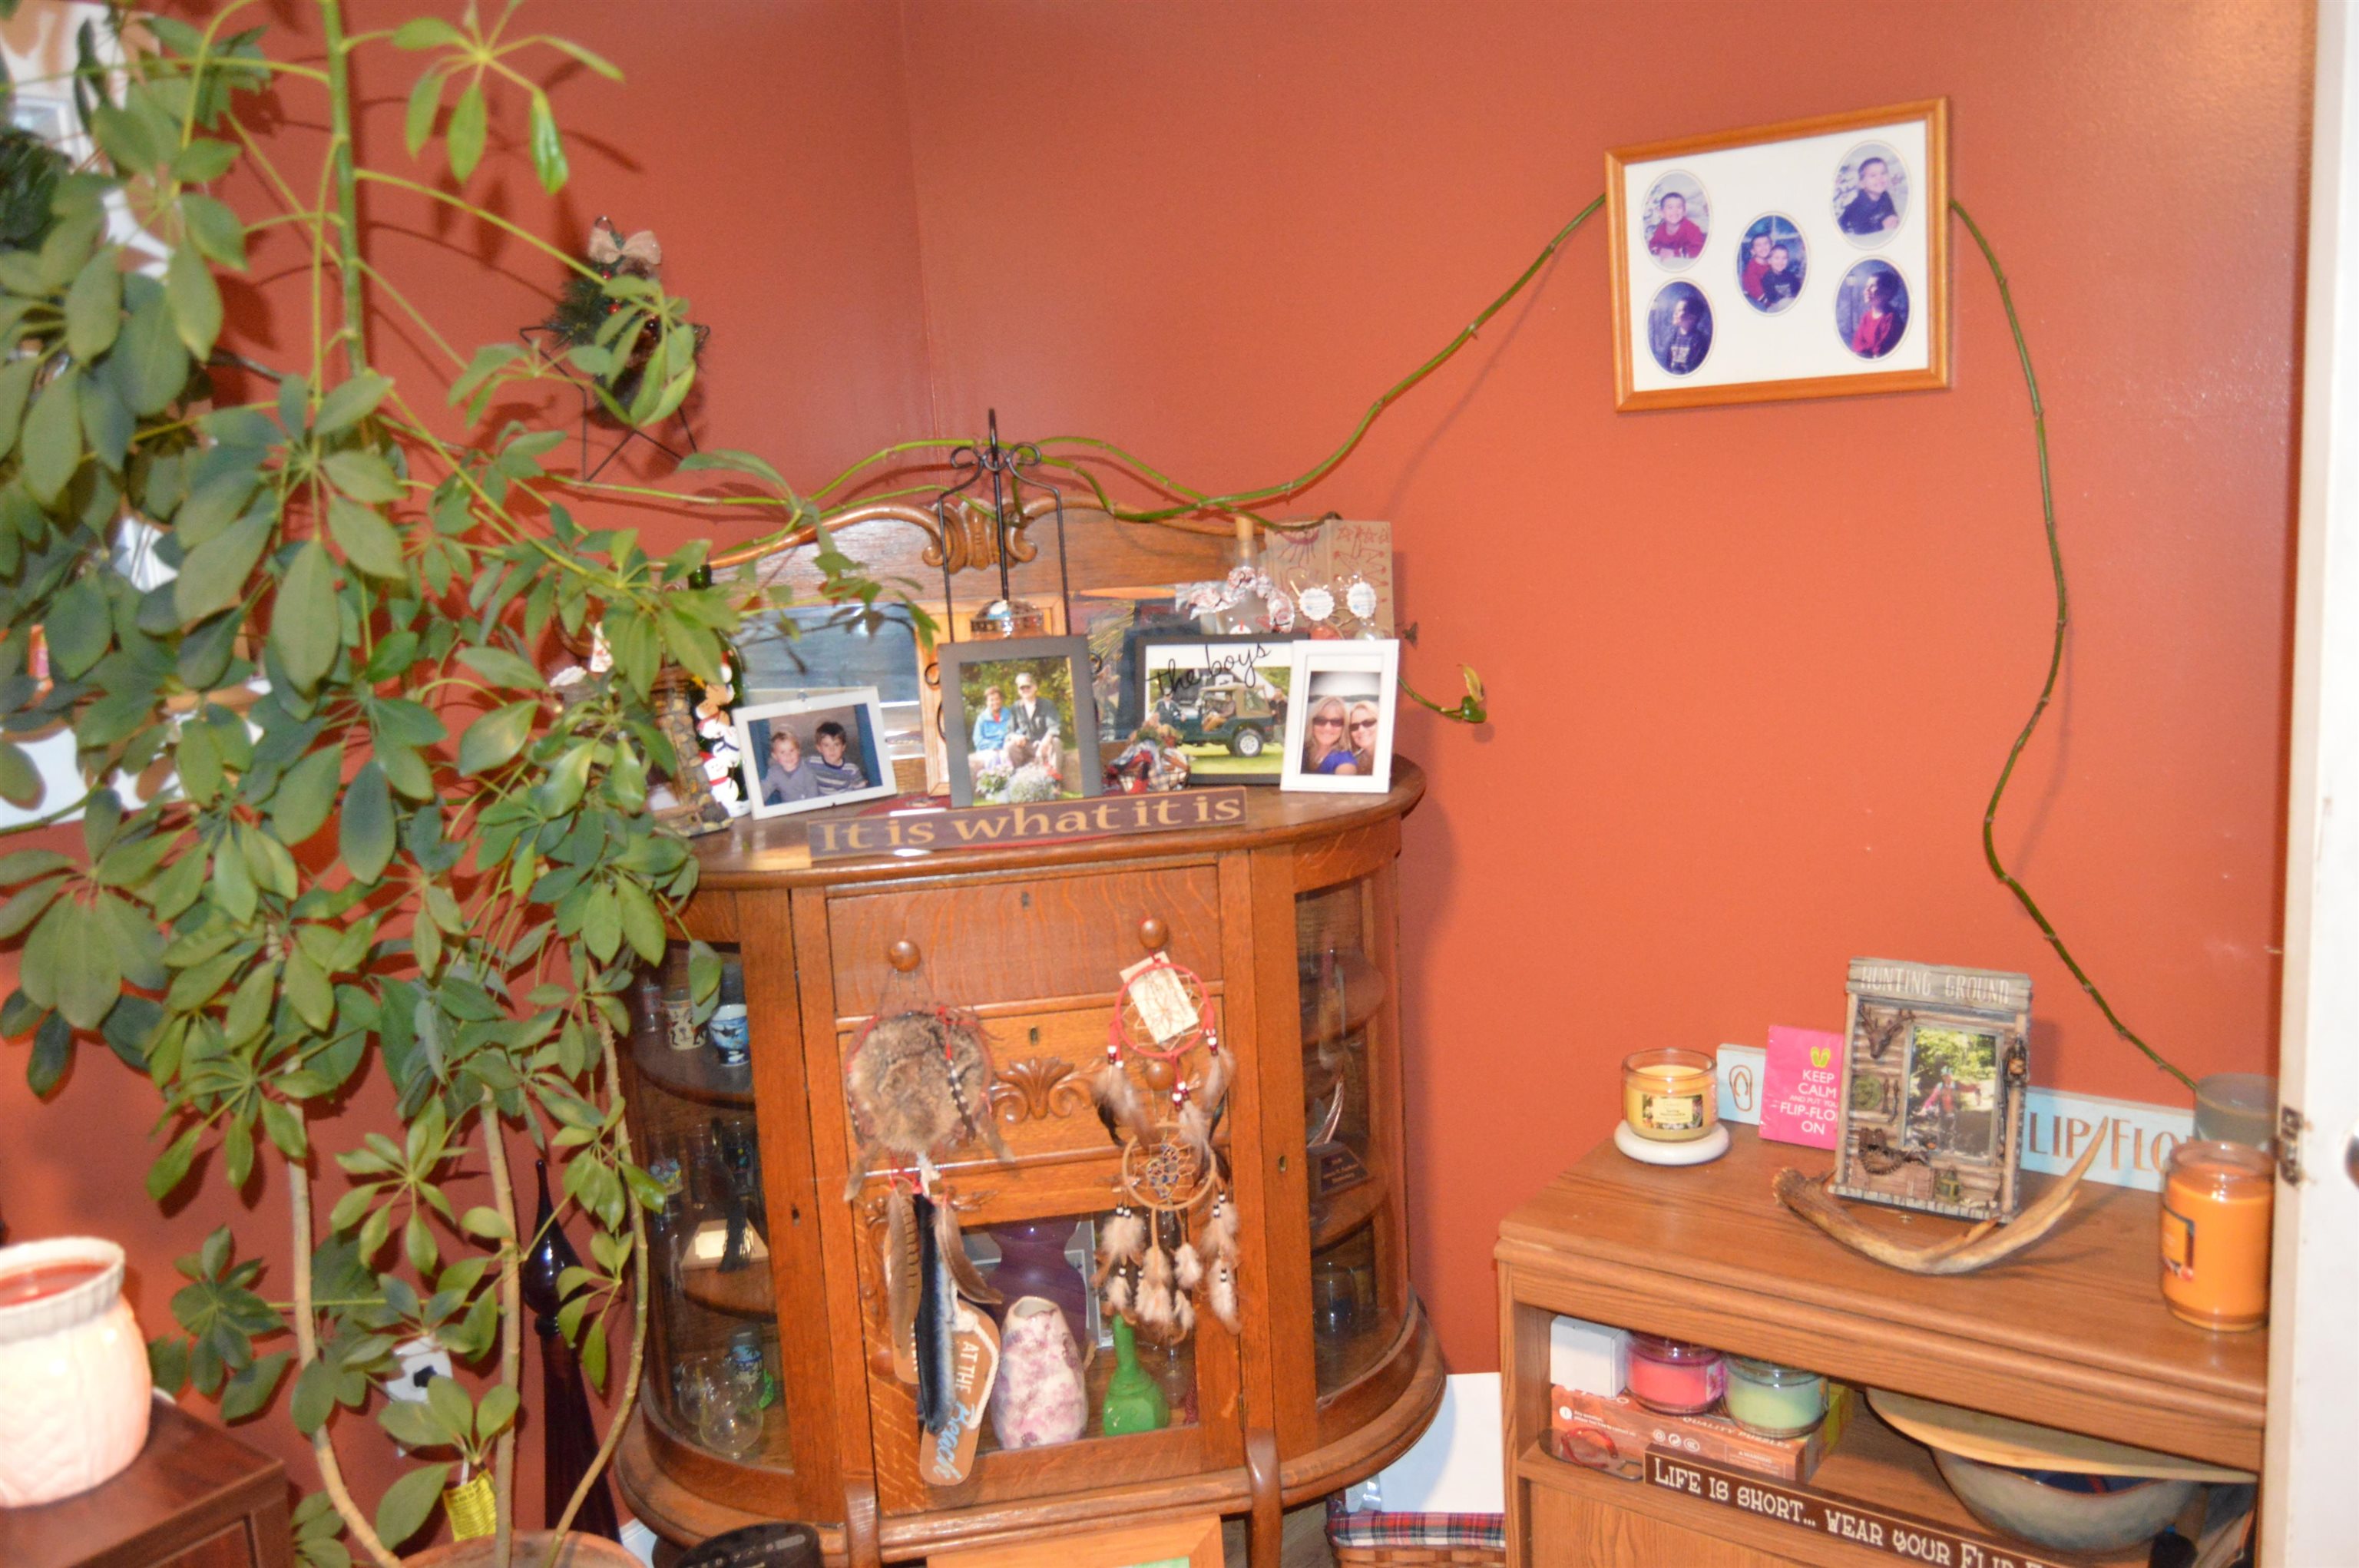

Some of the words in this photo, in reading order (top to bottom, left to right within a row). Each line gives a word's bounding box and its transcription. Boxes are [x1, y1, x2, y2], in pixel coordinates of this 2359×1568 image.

[1147, 658, 1203, 696] the
[1206, 643, 1272, 688] boys
[819, 822, 873, 851] It
[884, 819, 935, 846] is
[951, 804, 1120, 841] what
[1132, 799, 1183, 827] it
[1193, 796, 1241, 822] is
[1861, 966, 1931, 997] HUNTING
[1944, 974, 2010, 1005] GROUND
[1802, 1069, 1835, 1083] KEEP
[1798, 1082, 1837, 1100] CALM
[1780, 1101, 1837, 1122] FLIP-FLO
[1824, 1100, 1838, 1108] YOU
[1801, 1120, 1825, 1135] ON
[2028, 1111, 2092, 1159] LIP
[2109, 1118, 2185, 1175] FLO
[961, 1341, 980, 1363] AT
[955, 1365, 976, 1394] THE
[1682, 1417, 1735, 1434] QUALITY
[1654, 1457, 1702, 1494] LIFE
[1708, 1476, 1729, 1501] IS
[1736, 1486, 1816, 1527] SHORT...
[1825, 1509, 1883, 1546] WEAR
[1892, 1528, 1950, 1566] YOUR
